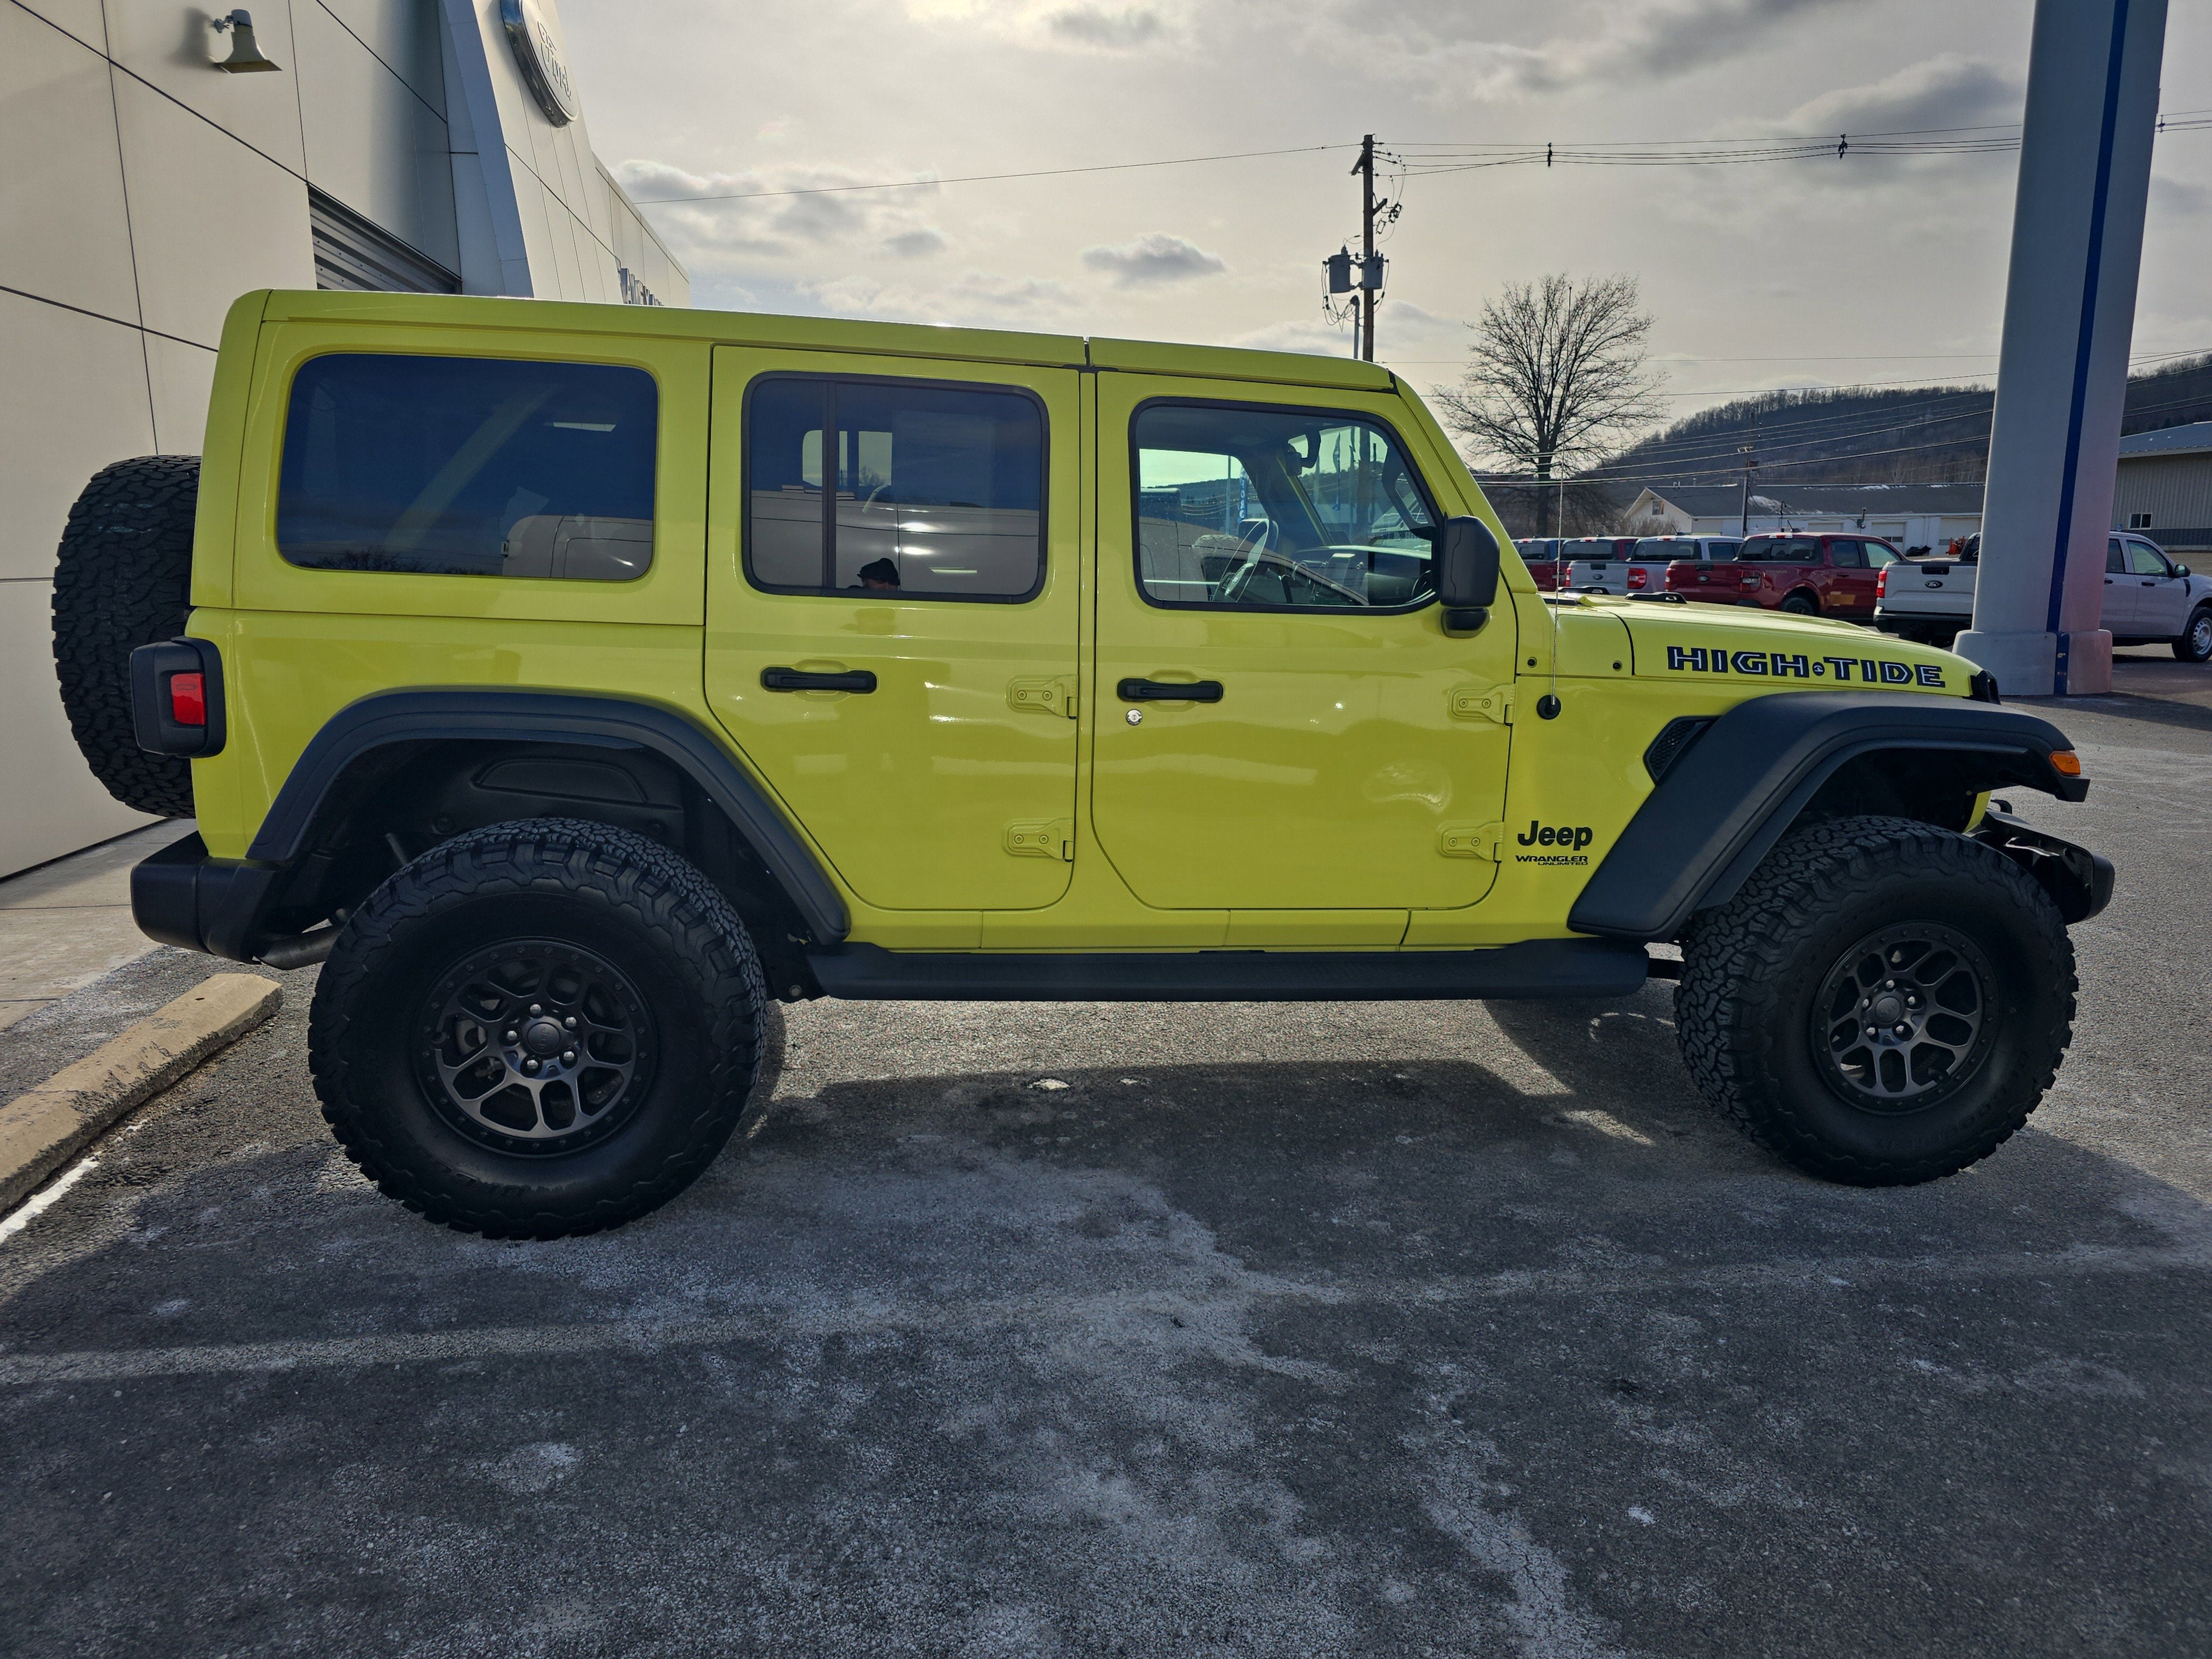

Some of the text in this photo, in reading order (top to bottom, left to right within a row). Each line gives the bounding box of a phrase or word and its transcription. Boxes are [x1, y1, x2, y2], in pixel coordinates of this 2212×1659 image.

[1667, 646, 1946, 688] HIGH TIDE
[1517, 820, 1593, 851] Jeep
